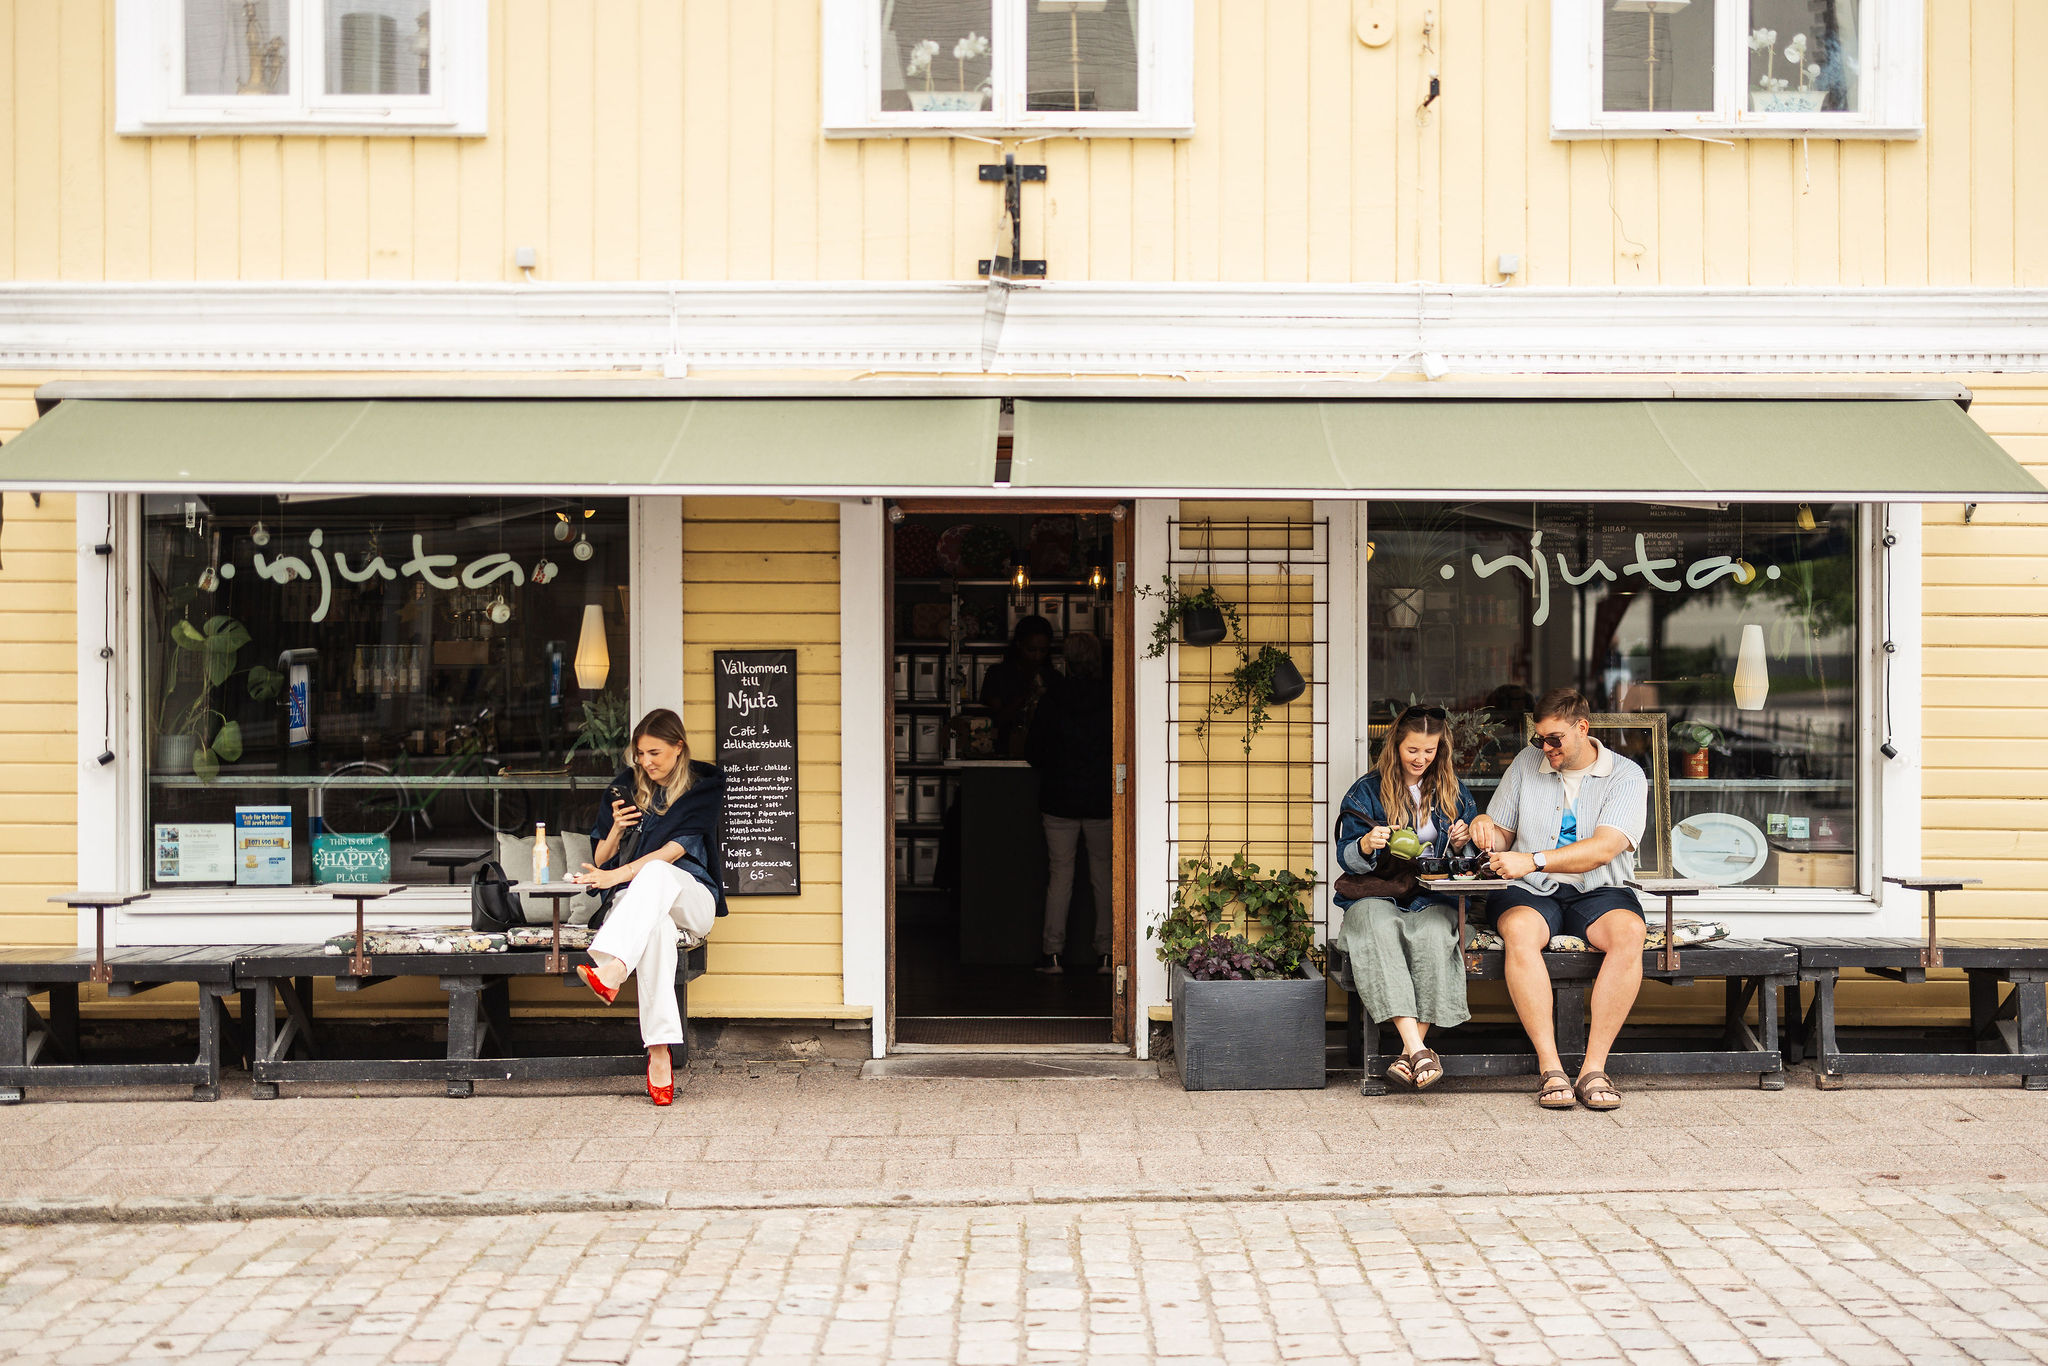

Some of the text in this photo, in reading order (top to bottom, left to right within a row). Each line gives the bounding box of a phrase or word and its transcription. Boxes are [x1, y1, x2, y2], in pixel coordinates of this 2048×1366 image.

[722, 658, 788, 674] Välkommen
[741, 676, 760, 686] till
[728, 690, 778, 716] Njuta
[730, 725, 757, 736] Café
[724, 738, 792, 750] delikatessbutik
[745, 764, 760, 772] teer
[747, 776, 772, 784] praliner
[330, 838, 348, 846] THIS
[728, 848, 752, 858] Kaffe
[324, 852, 380, 866] HAPPY
[725, 860, 750, 870] Njutas
[336, 874, 368, 882] PLACE
